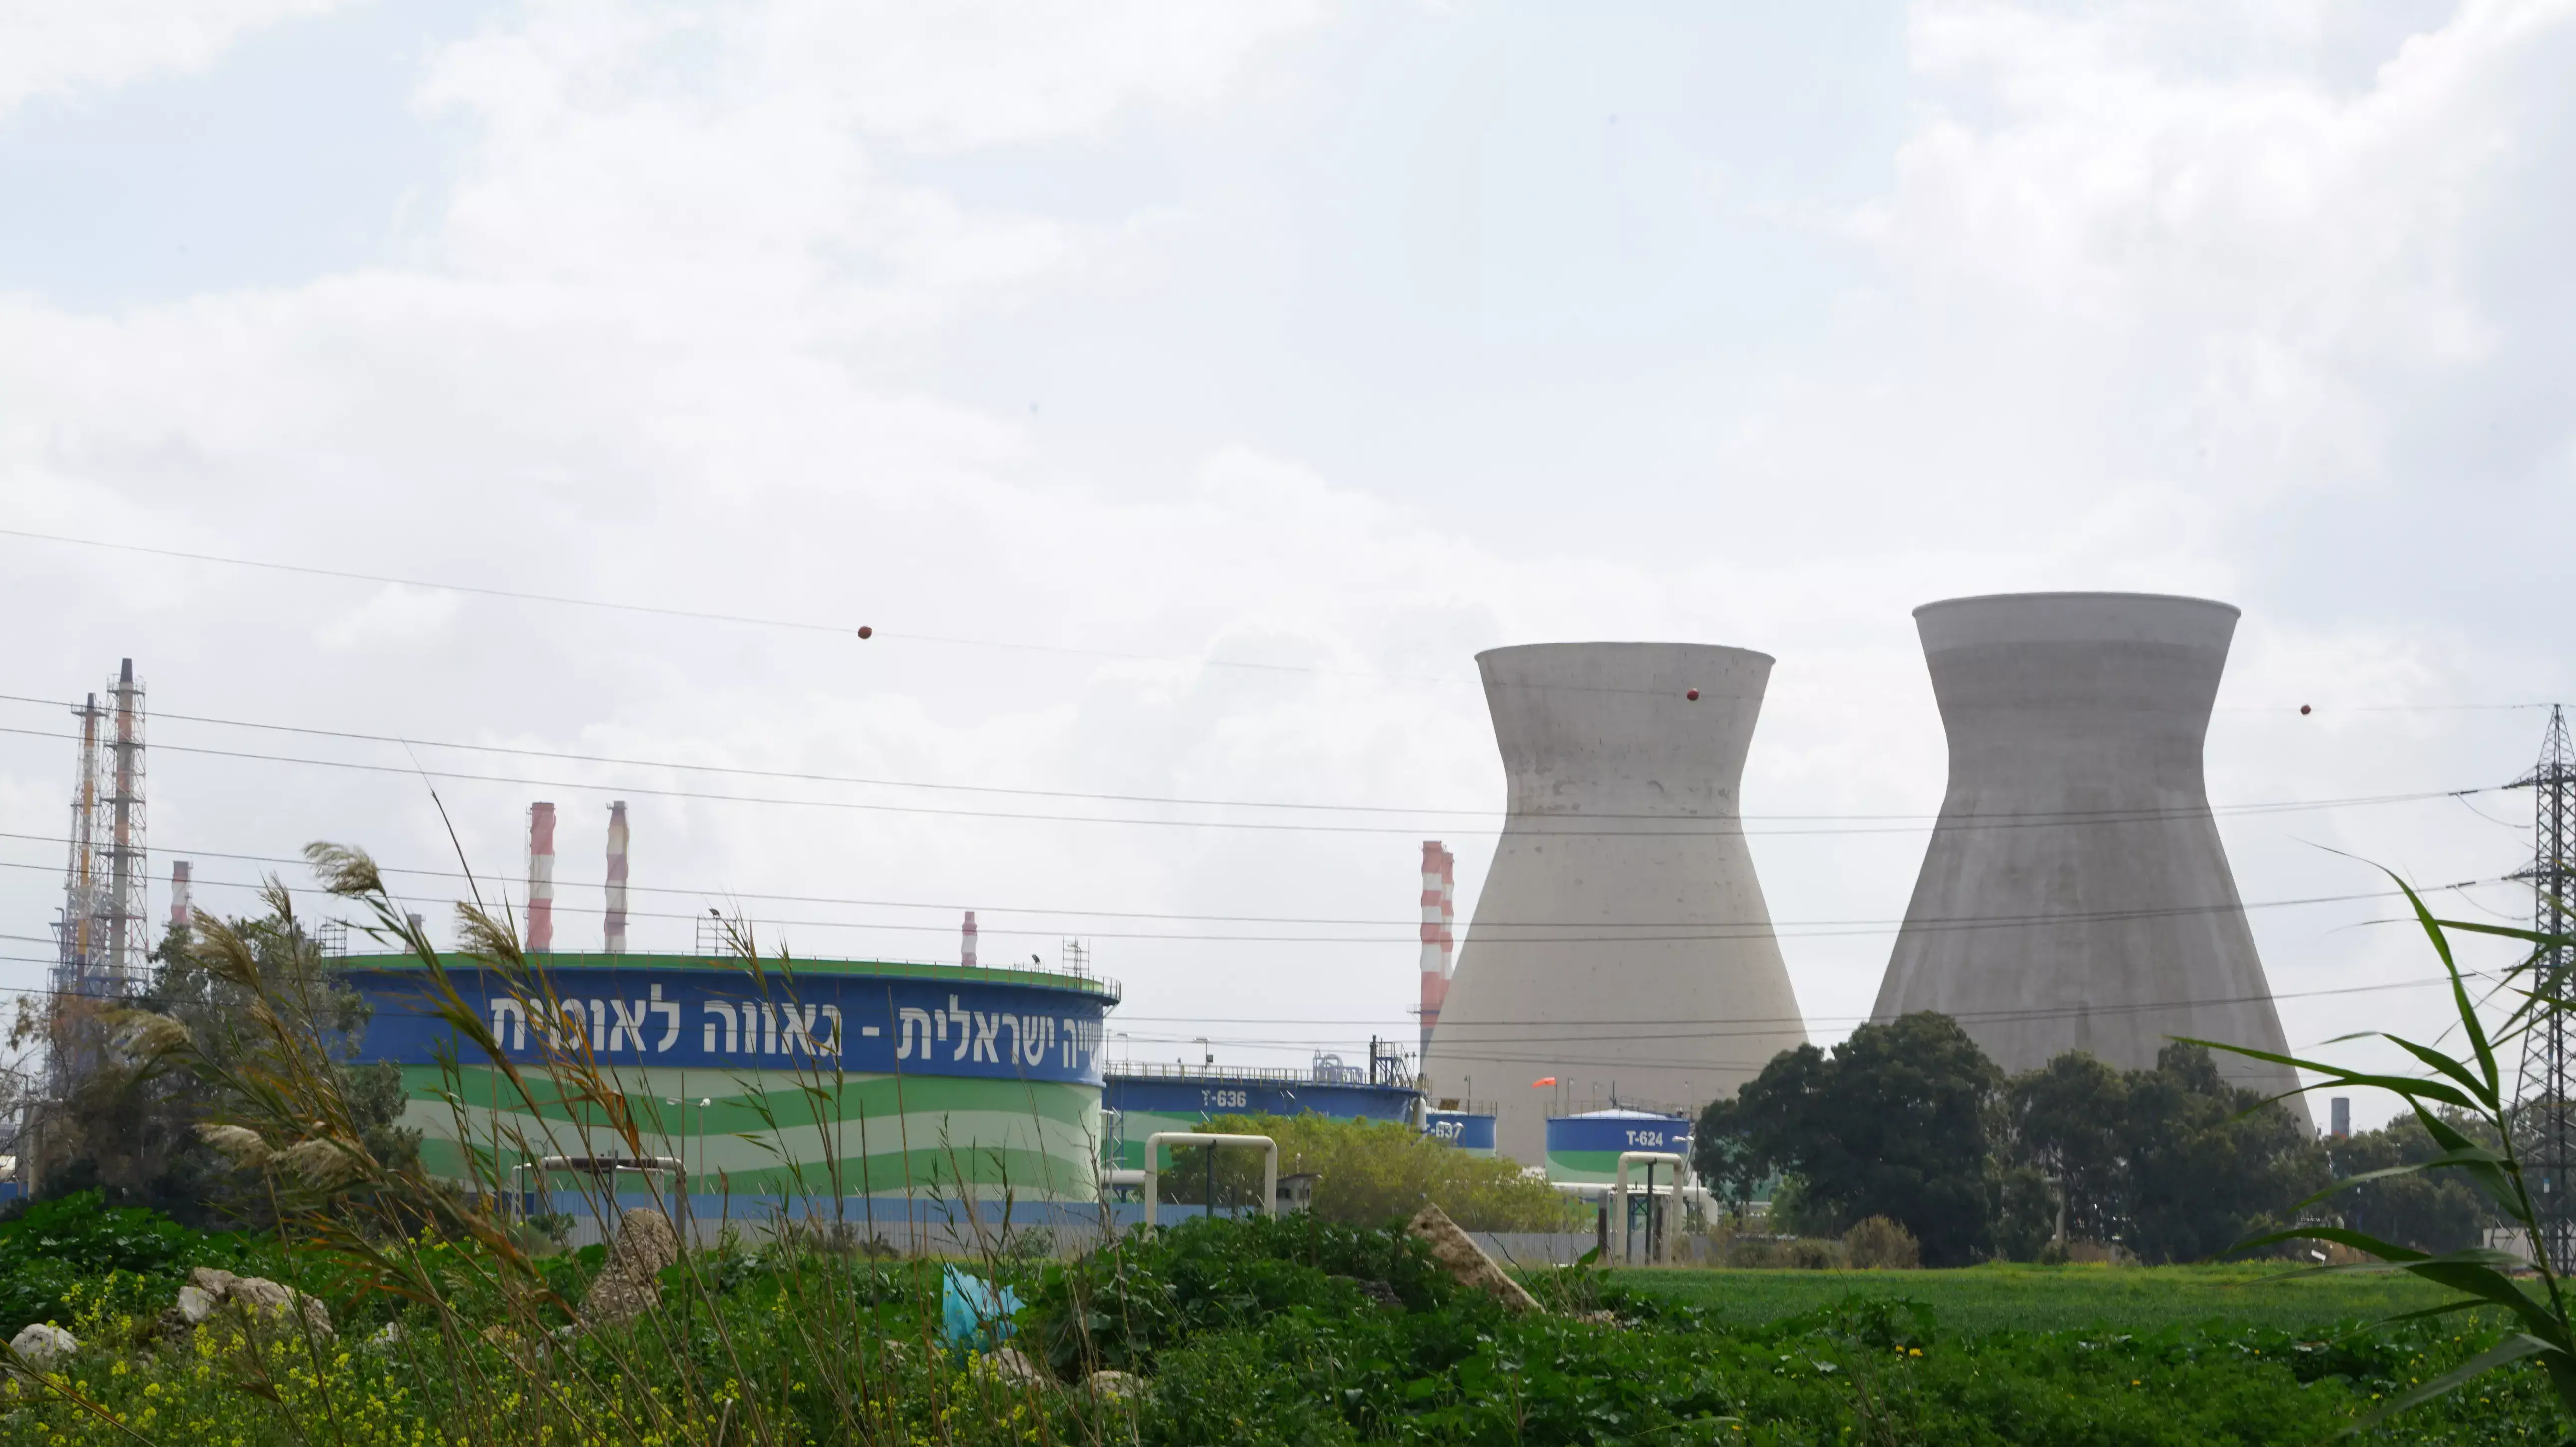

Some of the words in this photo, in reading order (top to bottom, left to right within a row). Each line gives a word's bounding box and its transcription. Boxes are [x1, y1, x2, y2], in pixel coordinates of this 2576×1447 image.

[491, 983, 680, 1052] לאומית
[704, 1000, 842, 1057] גאווה
[897, 994, 1055, 1066] ישראלית
[1201, 1090, 1246, 1107] T-636
[1426, 1122, 1462, 1138] -637
[1626, 1130, 1663, 1147] T-624
